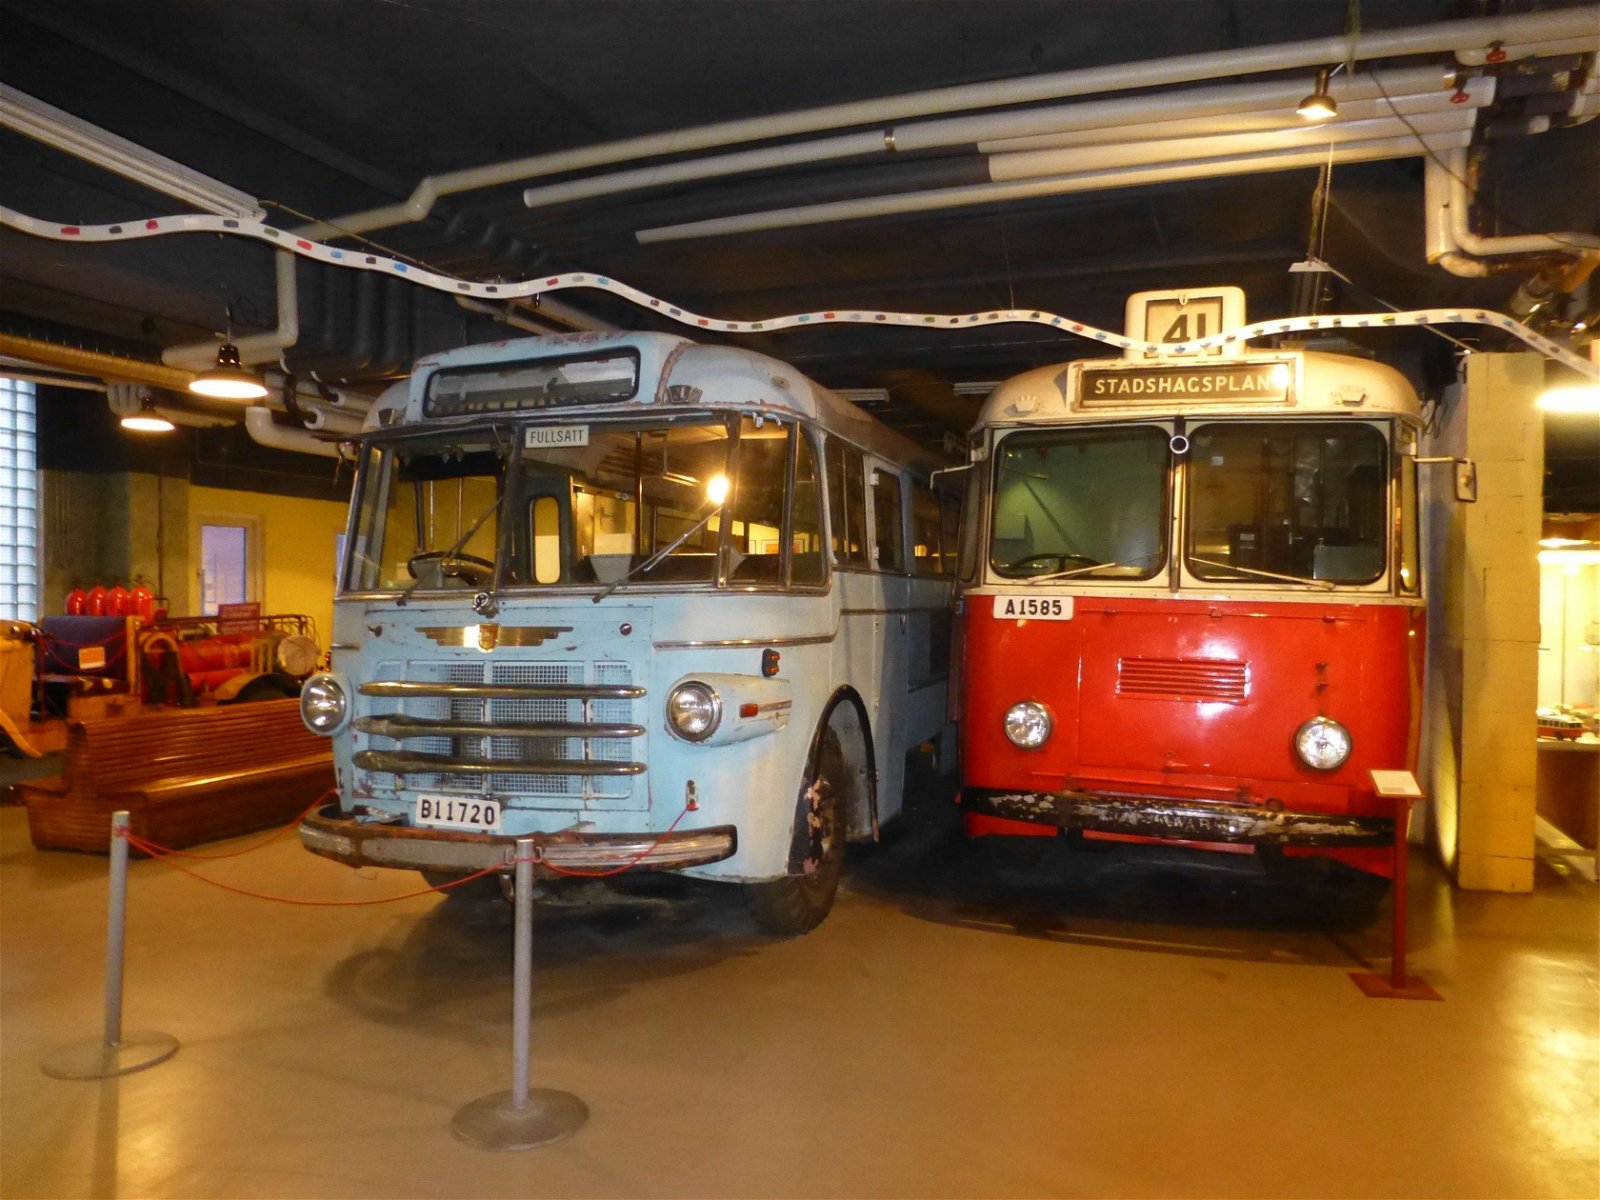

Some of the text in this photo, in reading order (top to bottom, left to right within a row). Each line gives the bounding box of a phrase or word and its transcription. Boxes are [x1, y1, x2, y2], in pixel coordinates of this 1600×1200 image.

[1162, 313, 1207, 344] 41
[1094, 375, 1270, 395] STADSHAGSPLAN
[530, 429, 585, 443] FULLSATT
[1004, 598, 1062, 616] A1585
[421, 799, 495, 825] B11720
